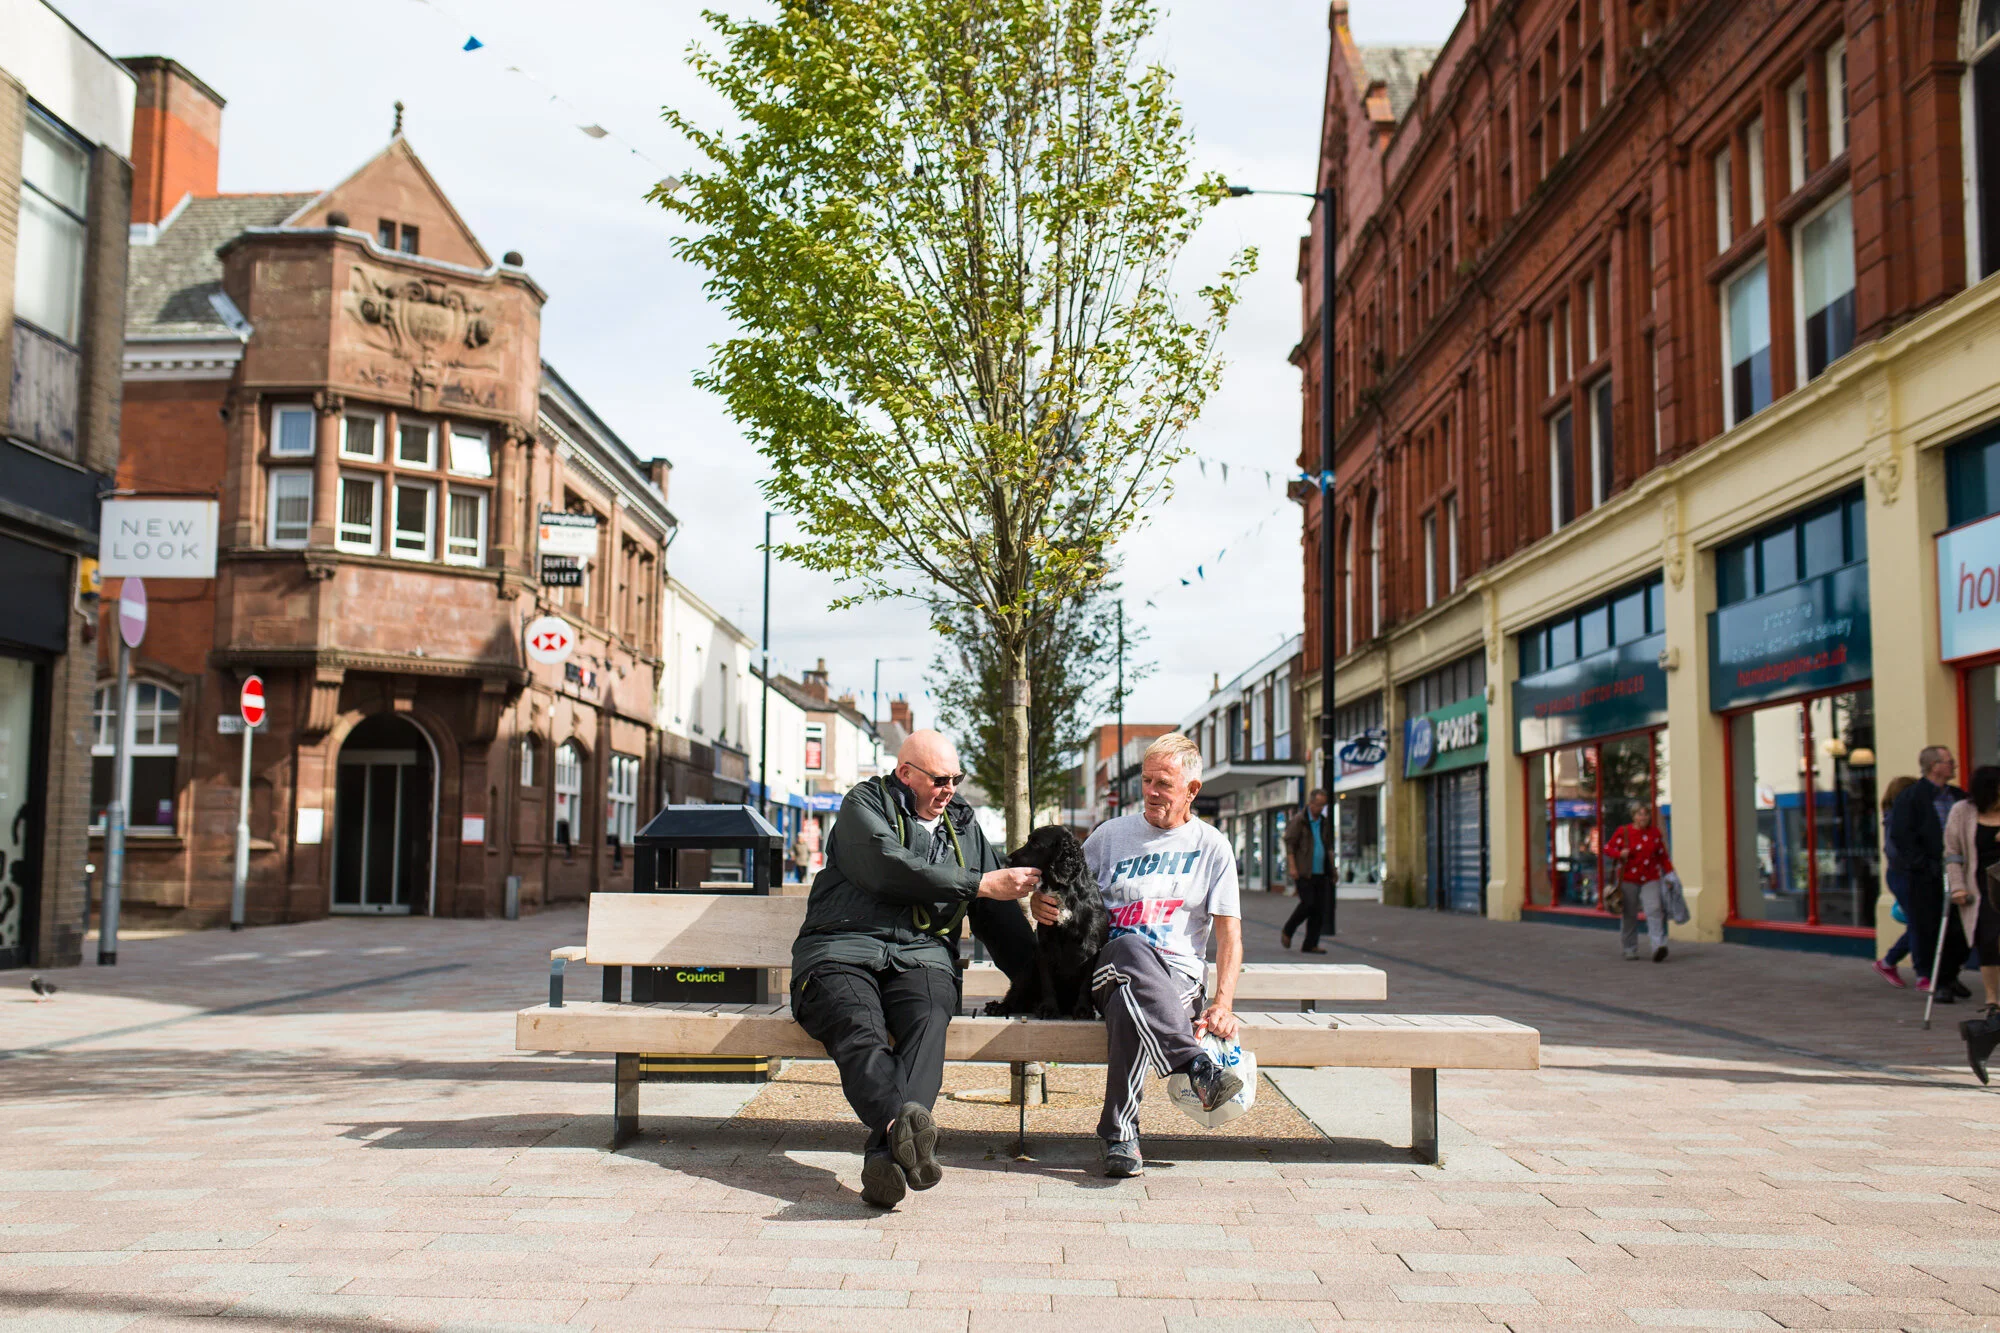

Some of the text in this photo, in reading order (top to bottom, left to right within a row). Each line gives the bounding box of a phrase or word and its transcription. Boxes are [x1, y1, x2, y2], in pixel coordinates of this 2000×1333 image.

[120, 518, 194, 537] NEW
[113, 541, 199, 560] LOOK
[544, 572, 578, 584] TO LET
[1958, 561, 2000, 614] ho
[1437, 711, 1478, 752] SPORTS
[1343, 746, 1381, 762] JJB
[1111, 850, 1201, 884] FIGHT
[1108, 899, 1184, 927] FIGHT
[676, 971, 725, 983] Council
